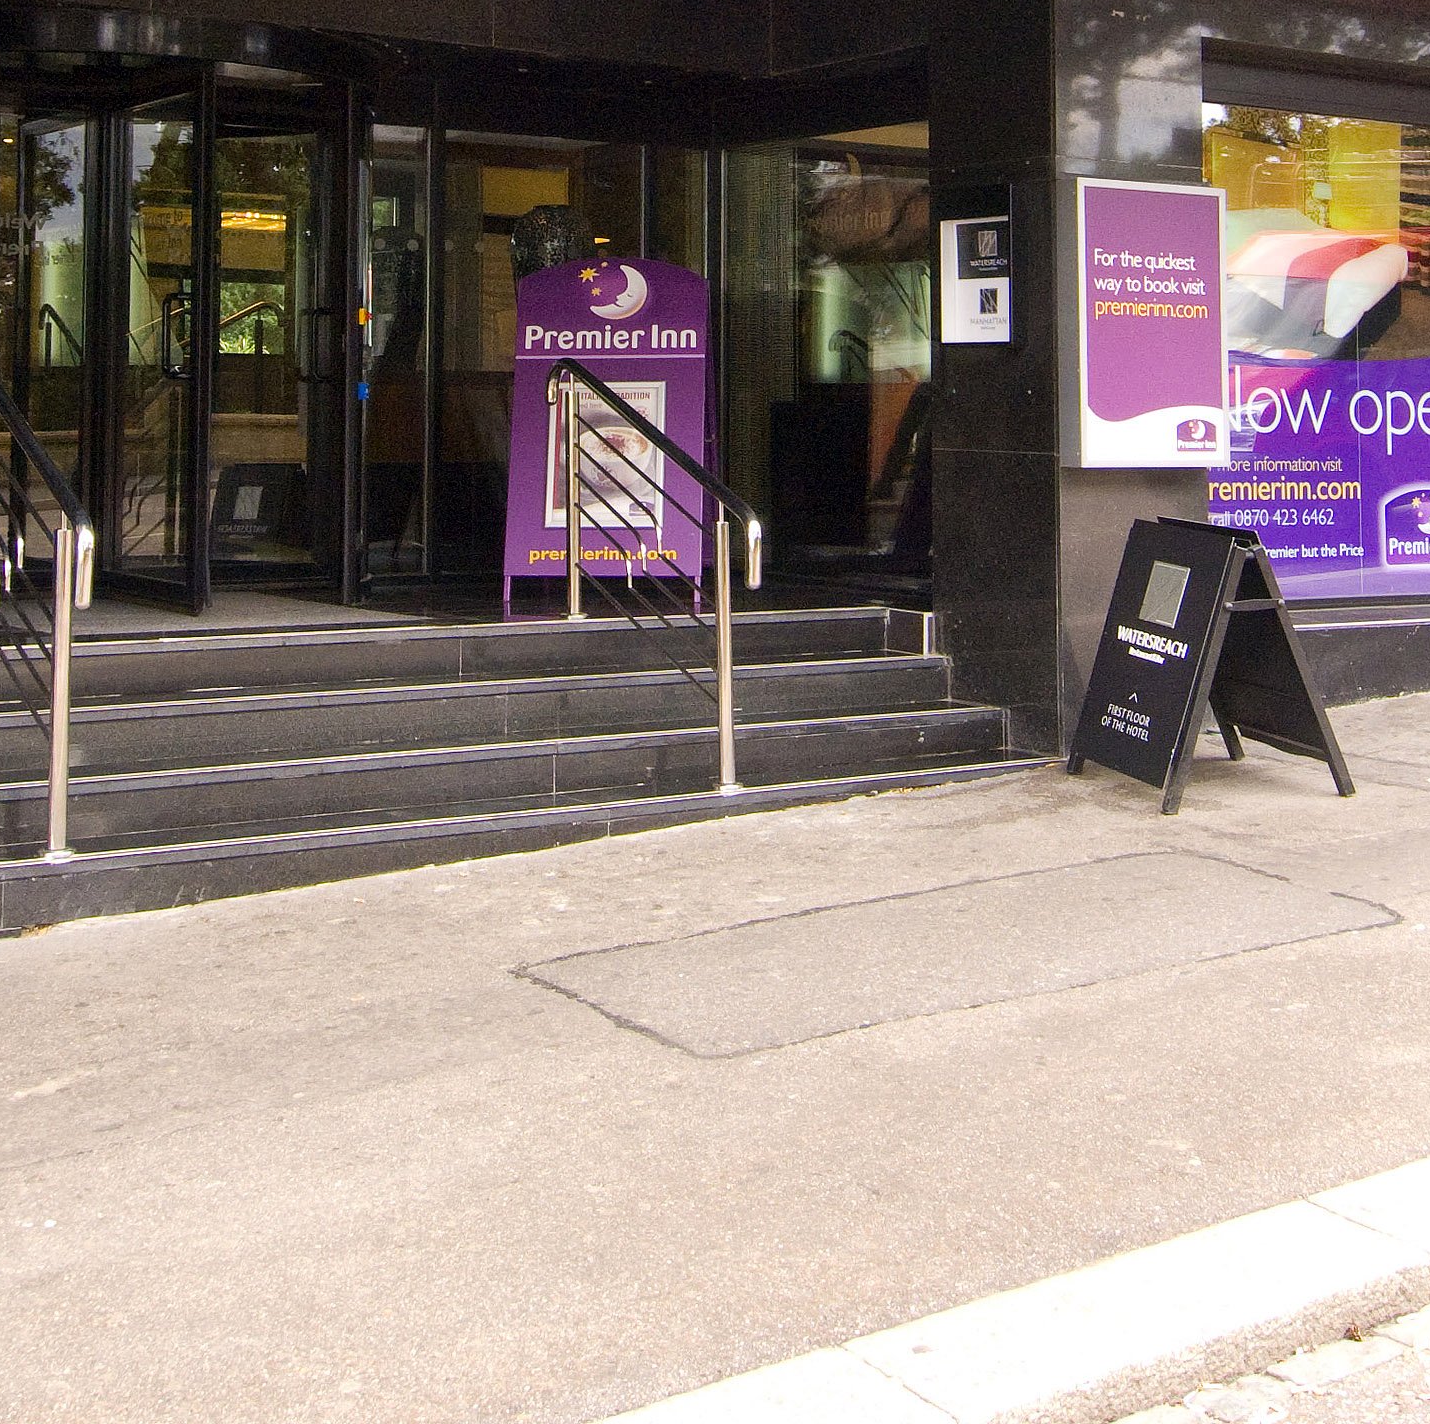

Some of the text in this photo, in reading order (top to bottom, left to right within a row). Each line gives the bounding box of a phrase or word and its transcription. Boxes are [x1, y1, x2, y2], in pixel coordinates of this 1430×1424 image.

[1094, 247, 1197, 274] For the quickest
[1094, 275, 1206, 296] way to book visit
[1094, 296, 1209, 321] premierinn.com
[524, 324, 698, 350] Premier Inn
[1254, 456, 1320, 473] information
[1321, 456, 1343, 473] visit
[1208, 475, 1362, 501] remierinn.com
[1234, 508, 1269, 527] 0870
[1272, 508, 1298, 526] 423
[1302, 507, 1335, 526] 6462
[1301, 544, 1319, 558] but
[1320, 543, 1338, 558] the
[1338, 542, 1365, 557] Price
[1117, 625, 1189, 659] WATERSREACH
[1107, 703, 1151, 728] FIRST FLOOR
[1101, 715, 1150, 742] OF THE HOTEL
